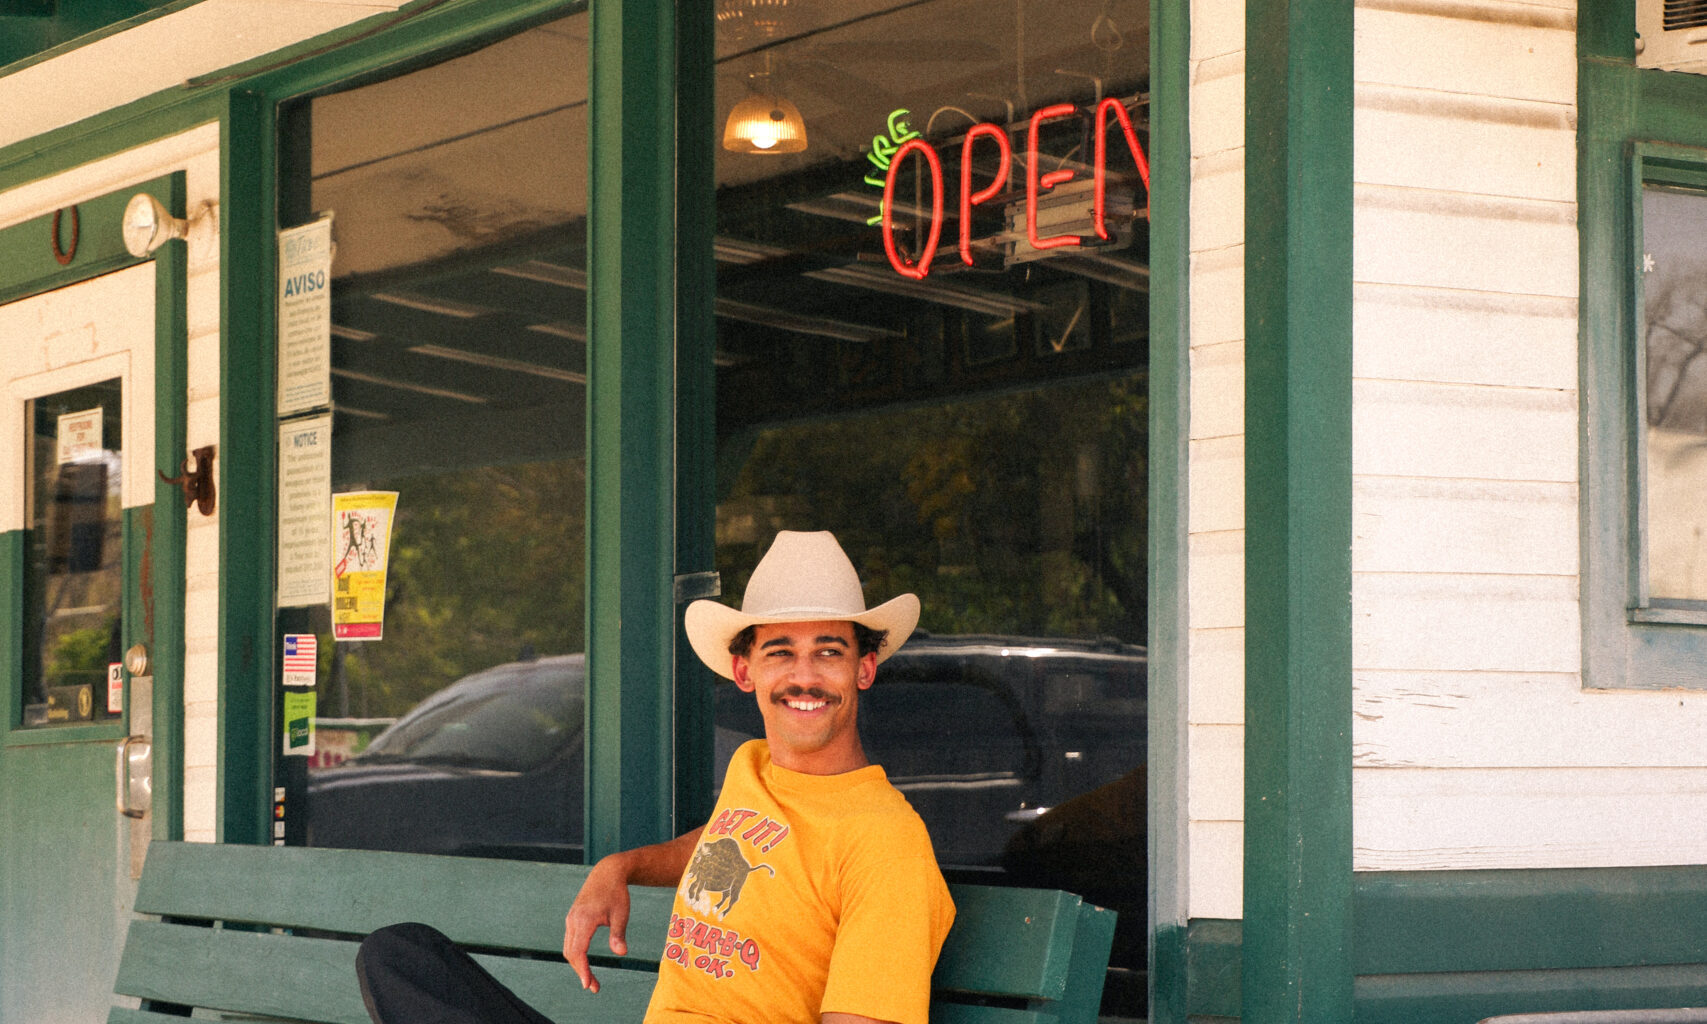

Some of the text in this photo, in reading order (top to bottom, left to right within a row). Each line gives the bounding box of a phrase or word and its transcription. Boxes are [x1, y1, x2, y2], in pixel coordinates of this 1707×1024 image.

[284, 269, 325, 298] AVISO
[293, 431, 318, 448] NOTICE
[709, 809, 790, 854] GET IT!
